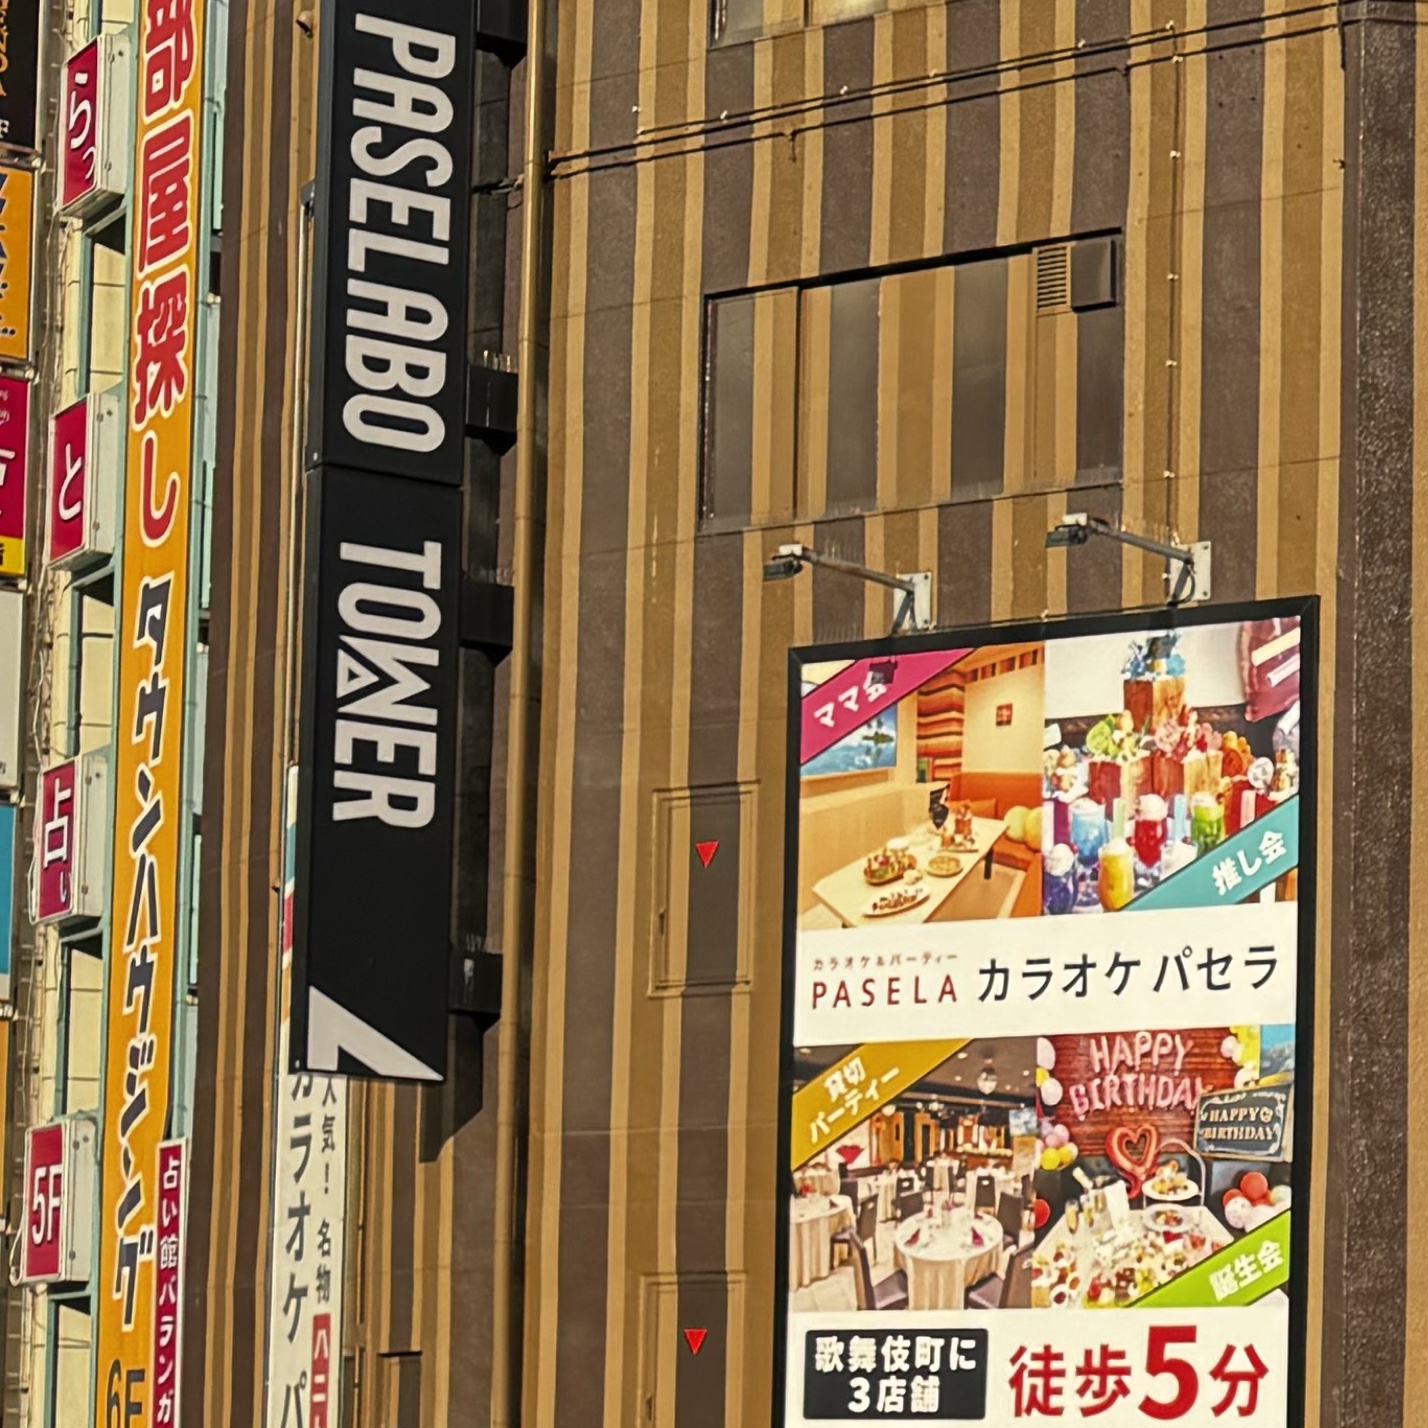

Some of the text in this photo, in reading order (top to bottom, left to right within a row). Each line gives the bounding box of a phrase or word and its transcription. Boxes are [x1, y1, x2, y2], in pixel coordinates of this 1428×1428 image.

[333, 13, 456, 828] PASELABO TOWER
[1212, 831, 1288, 896] 推し会
[812, 974, 958, 1009] PASELA
[1090, 1031, 1194, 1077] HAPPY
[1069, 1072, 1213, 1122] BIRTHDAY
[1209, 1107, 1260, 1123] HAPPY
[1203, 1127, 1276, 1141] BIRTHDAY
[32, 1165, 63, 1246] 5F
[814, 1335, 977, 1373] 歌舞伎町に
[1008, 1325, 1269, 1421] 徒歩5分
[847, 1377, 941, 1413] 3店舗
